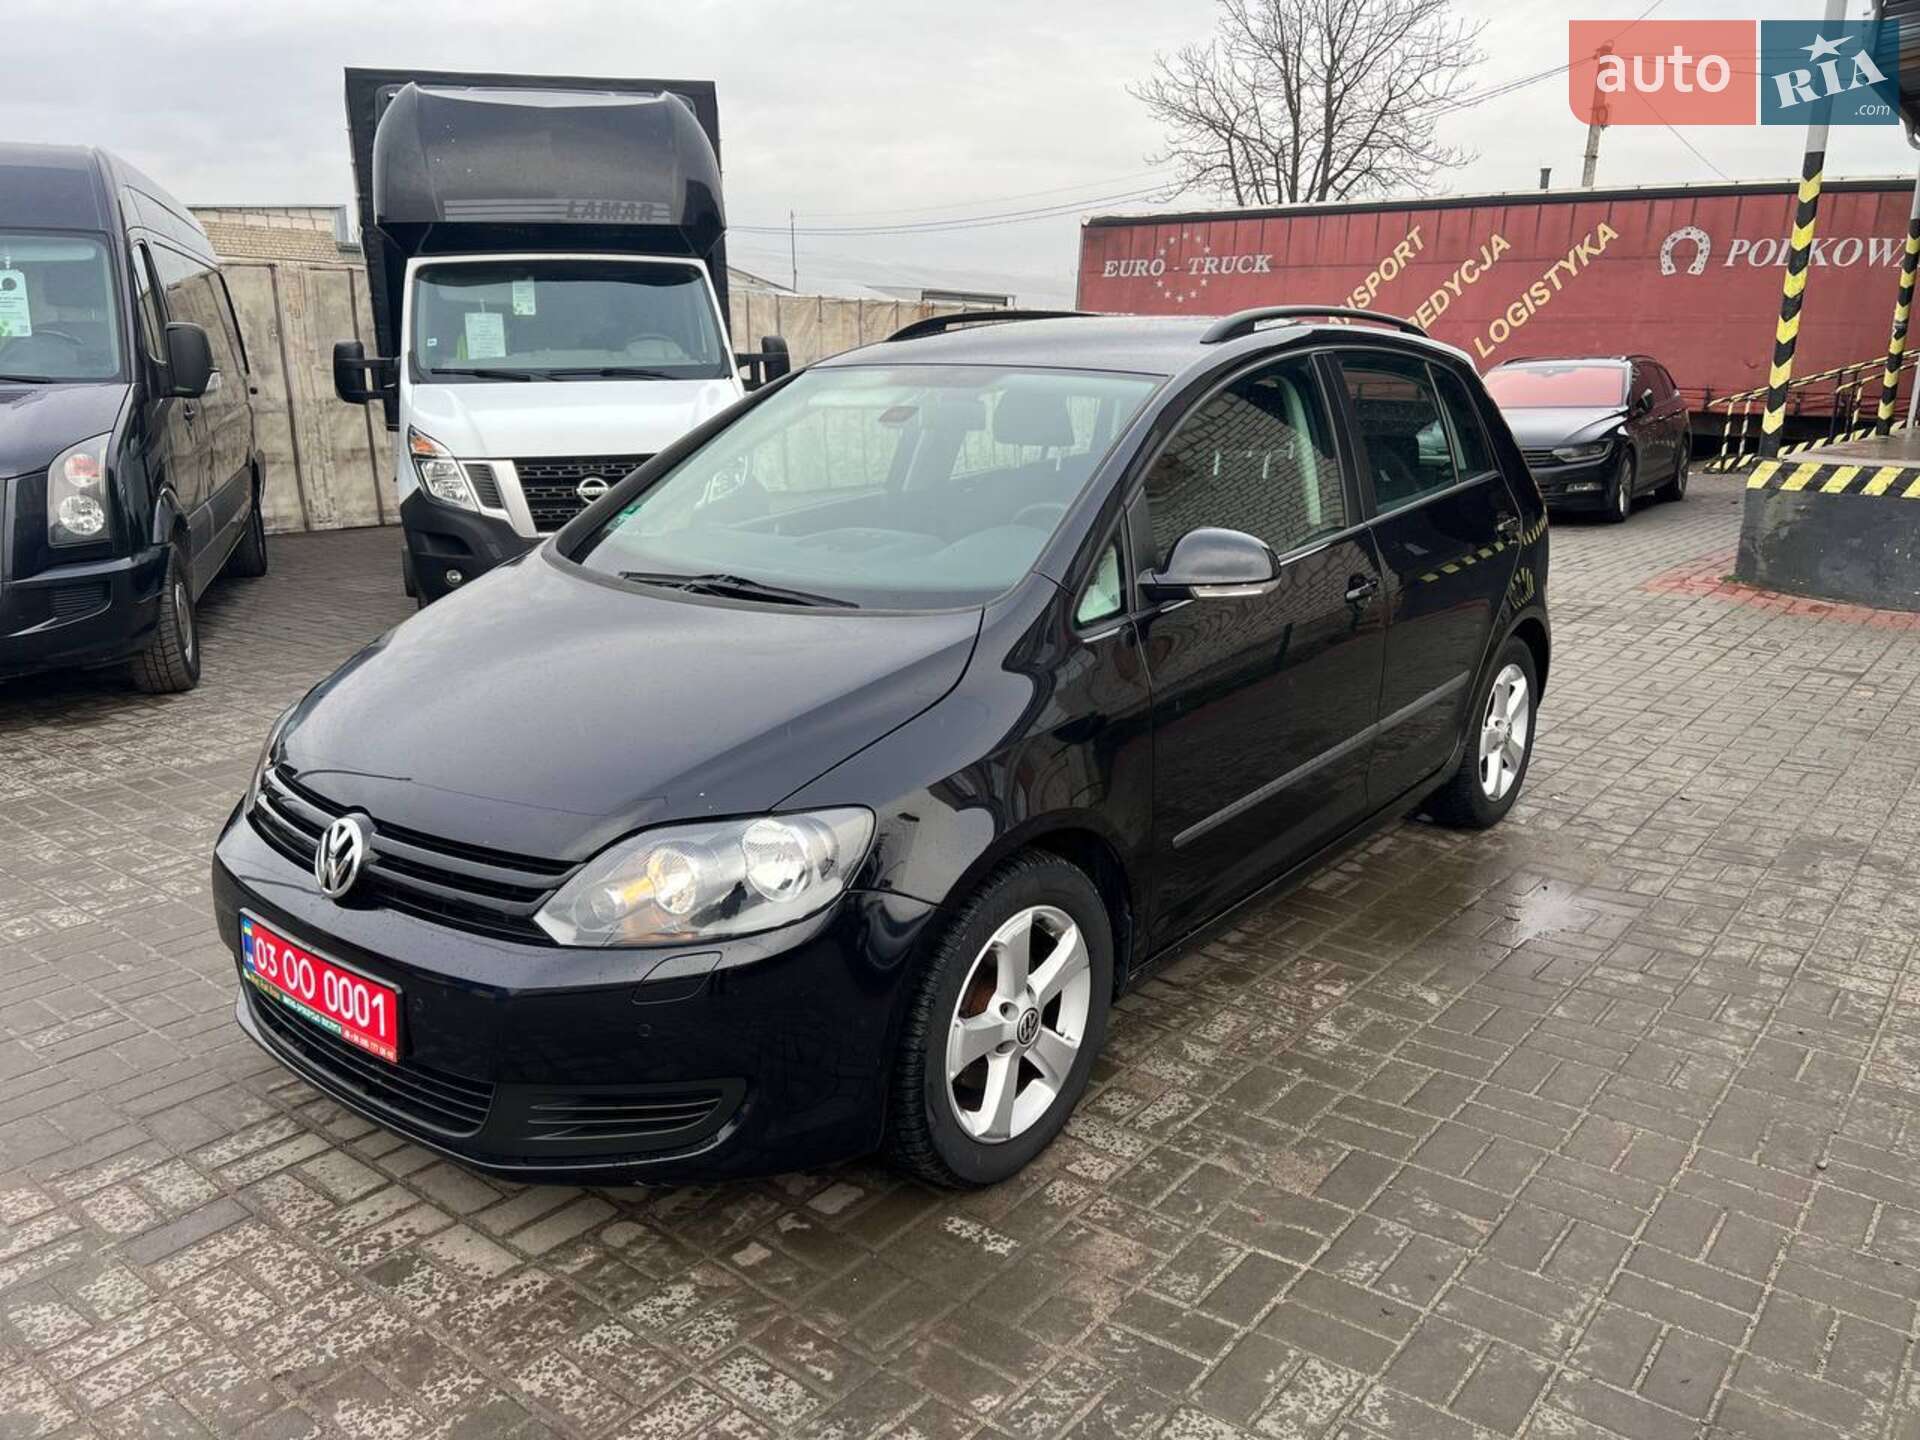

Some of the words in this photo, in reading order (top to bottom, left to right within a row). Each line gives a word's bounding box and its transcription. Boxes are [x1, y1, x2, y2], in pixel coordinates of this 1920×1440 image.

[566, 200, 655, 221] LAMAR
[1103, 259, 1165, 278] EURO
[1188, 254, 1272, 276] TRUCK
[1473, 222, 1619, 359] LOGISTYKA
[256, 937, 278, 978] 03
[323, 970, 385, 1037] 0001
